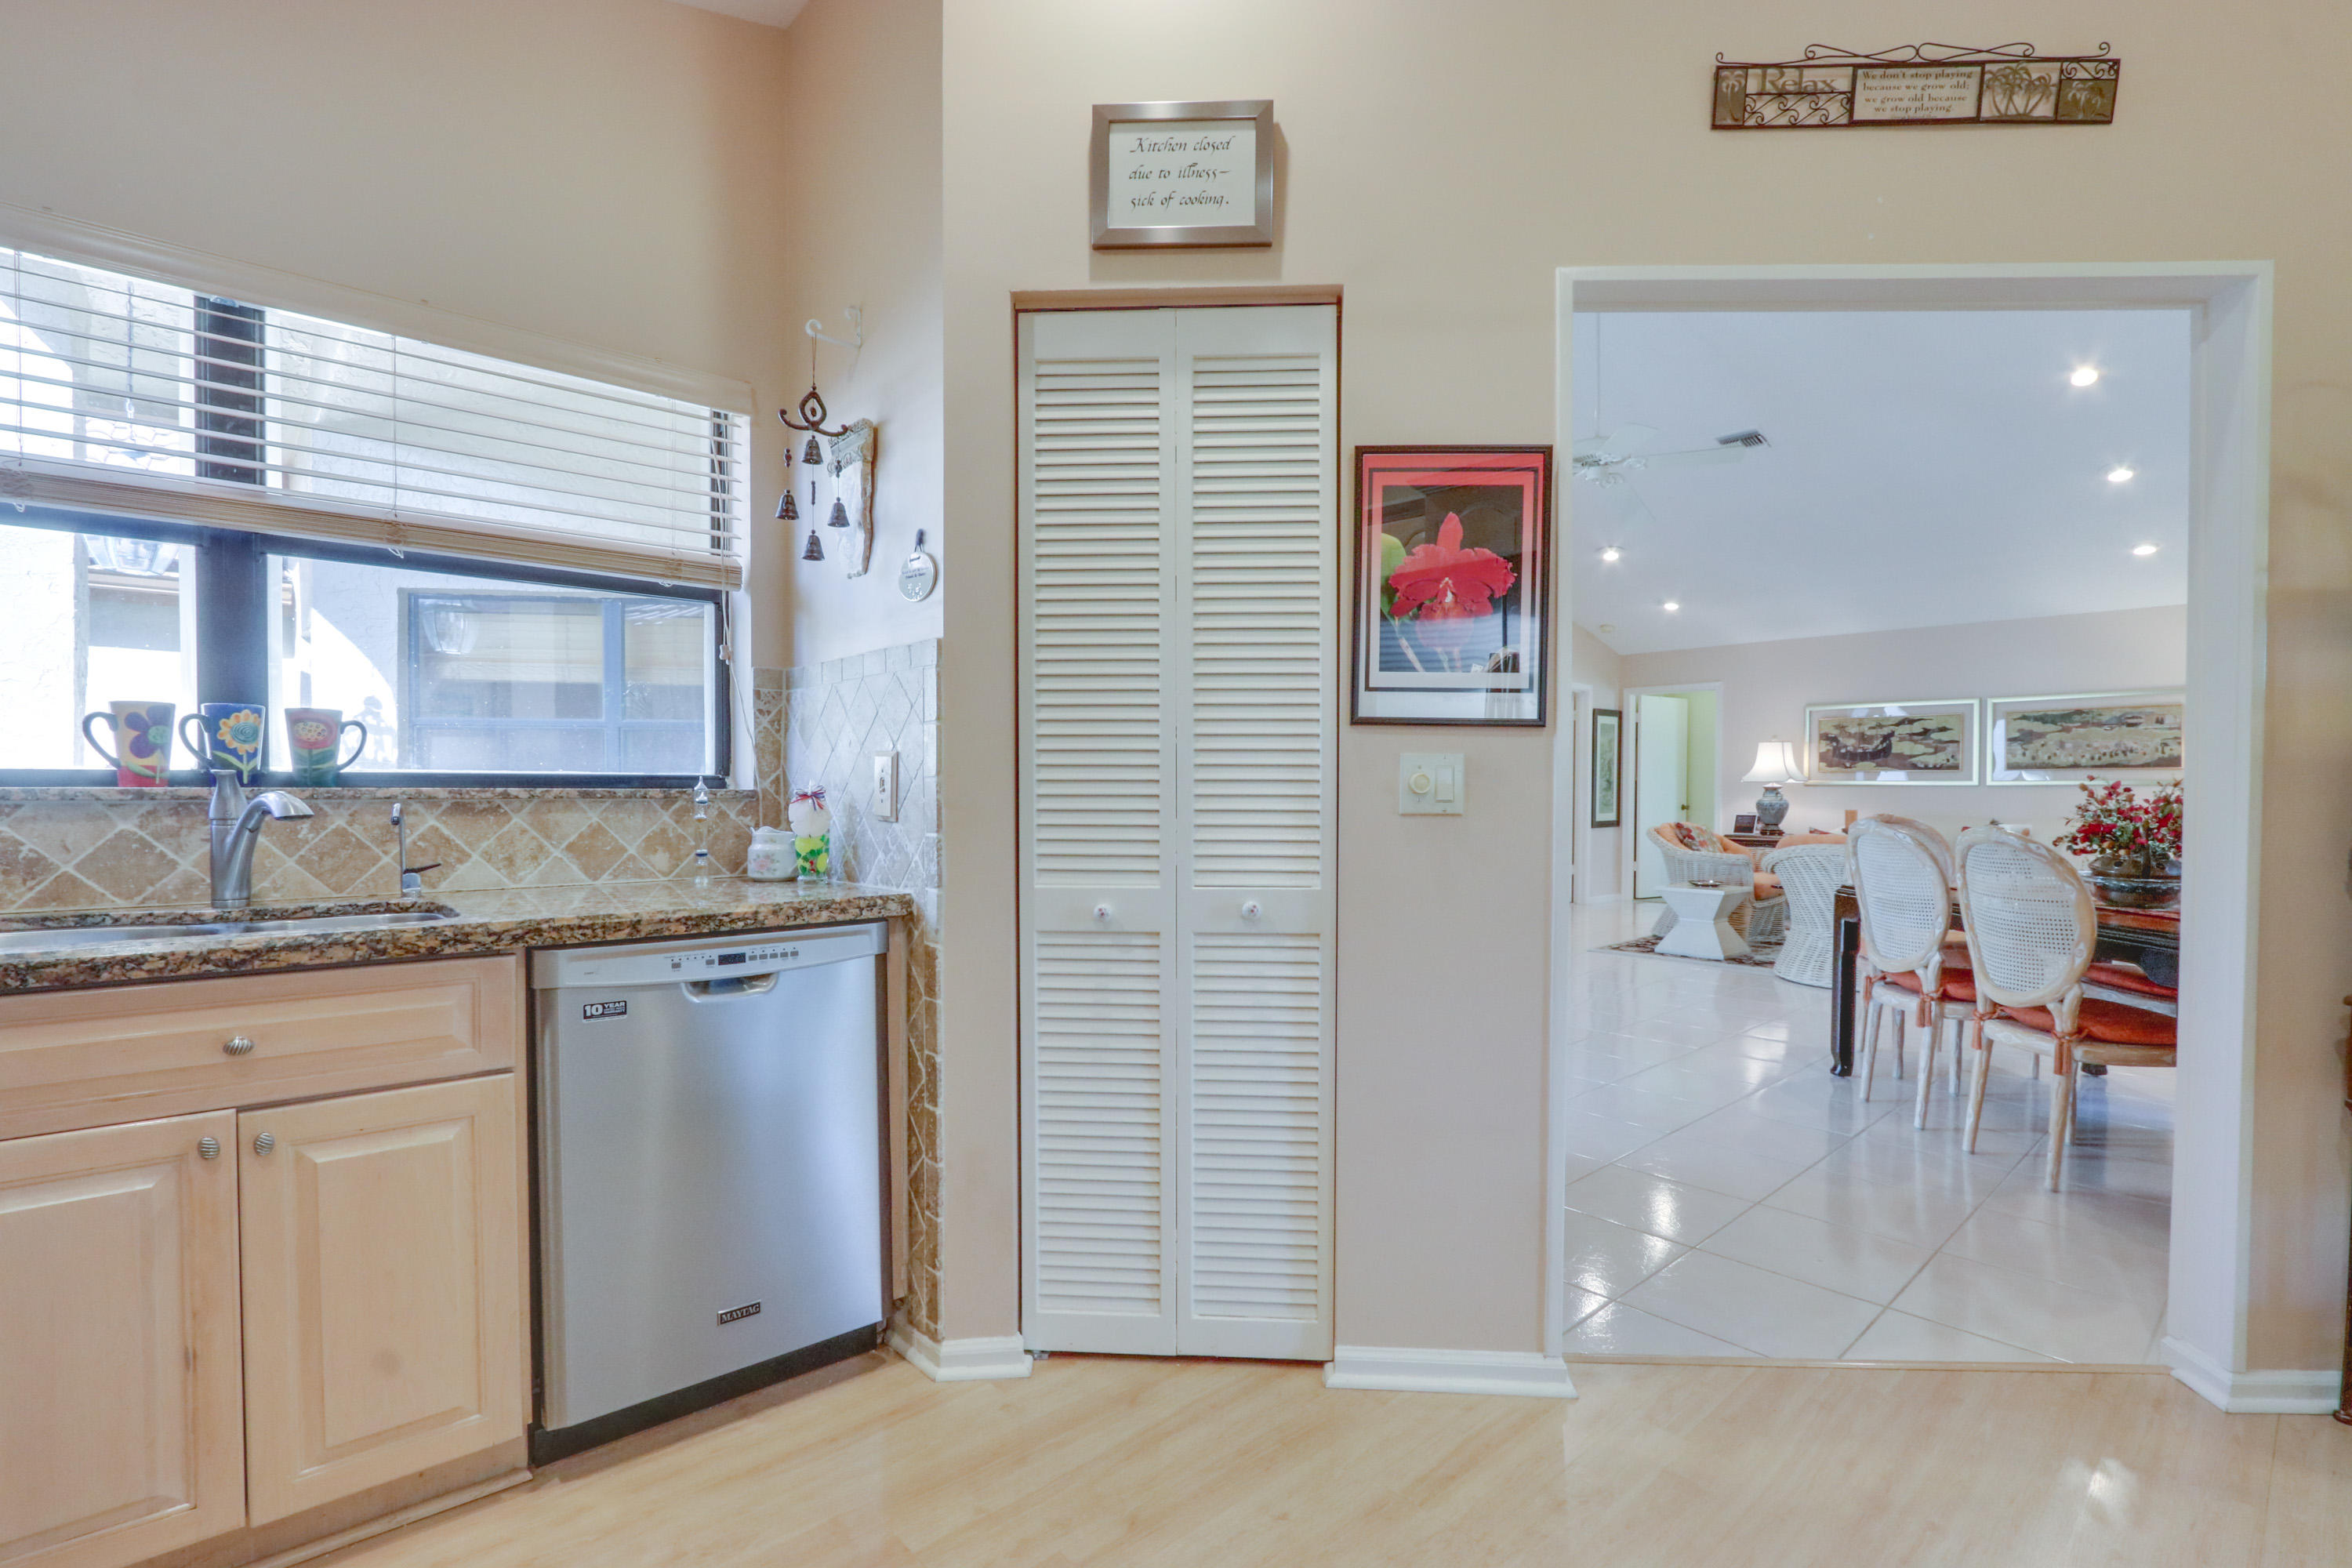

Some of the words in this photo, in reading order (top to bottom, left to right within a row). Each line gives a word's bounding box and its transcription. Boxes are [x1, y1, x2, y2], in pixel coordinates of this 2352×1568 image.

[1759, 67, 1839, 93] Relax
[1862, 71, 1876, 79] We
[1879, 70, 1905, 79] don't
[1910, 71, 1932, 80] stop
[1934, 69, 1973, 80] playing
[1863, 82, 1901, 91] because
[1881, 95, 1905, 103] grow
[1908, 93, 1924, 102] old
[1928, 93, 1967, 102] because
[1890, 105, 1912, 114] stop
[1130, 136, 1187, 152] Kitchen
[1192, 136, 1236, 155] closed
[1129, 165, 1152, 180] due
[1159, 169, 1171, 179] to
[1131, 191, 1156, 212] sick
[1160, 191, 1177, 210] of
[1179, 190, 1229, 210] cooking.
[584, 1004, 604, 1017] 10
[721, 1304, 759, 1323] MAYTAG
